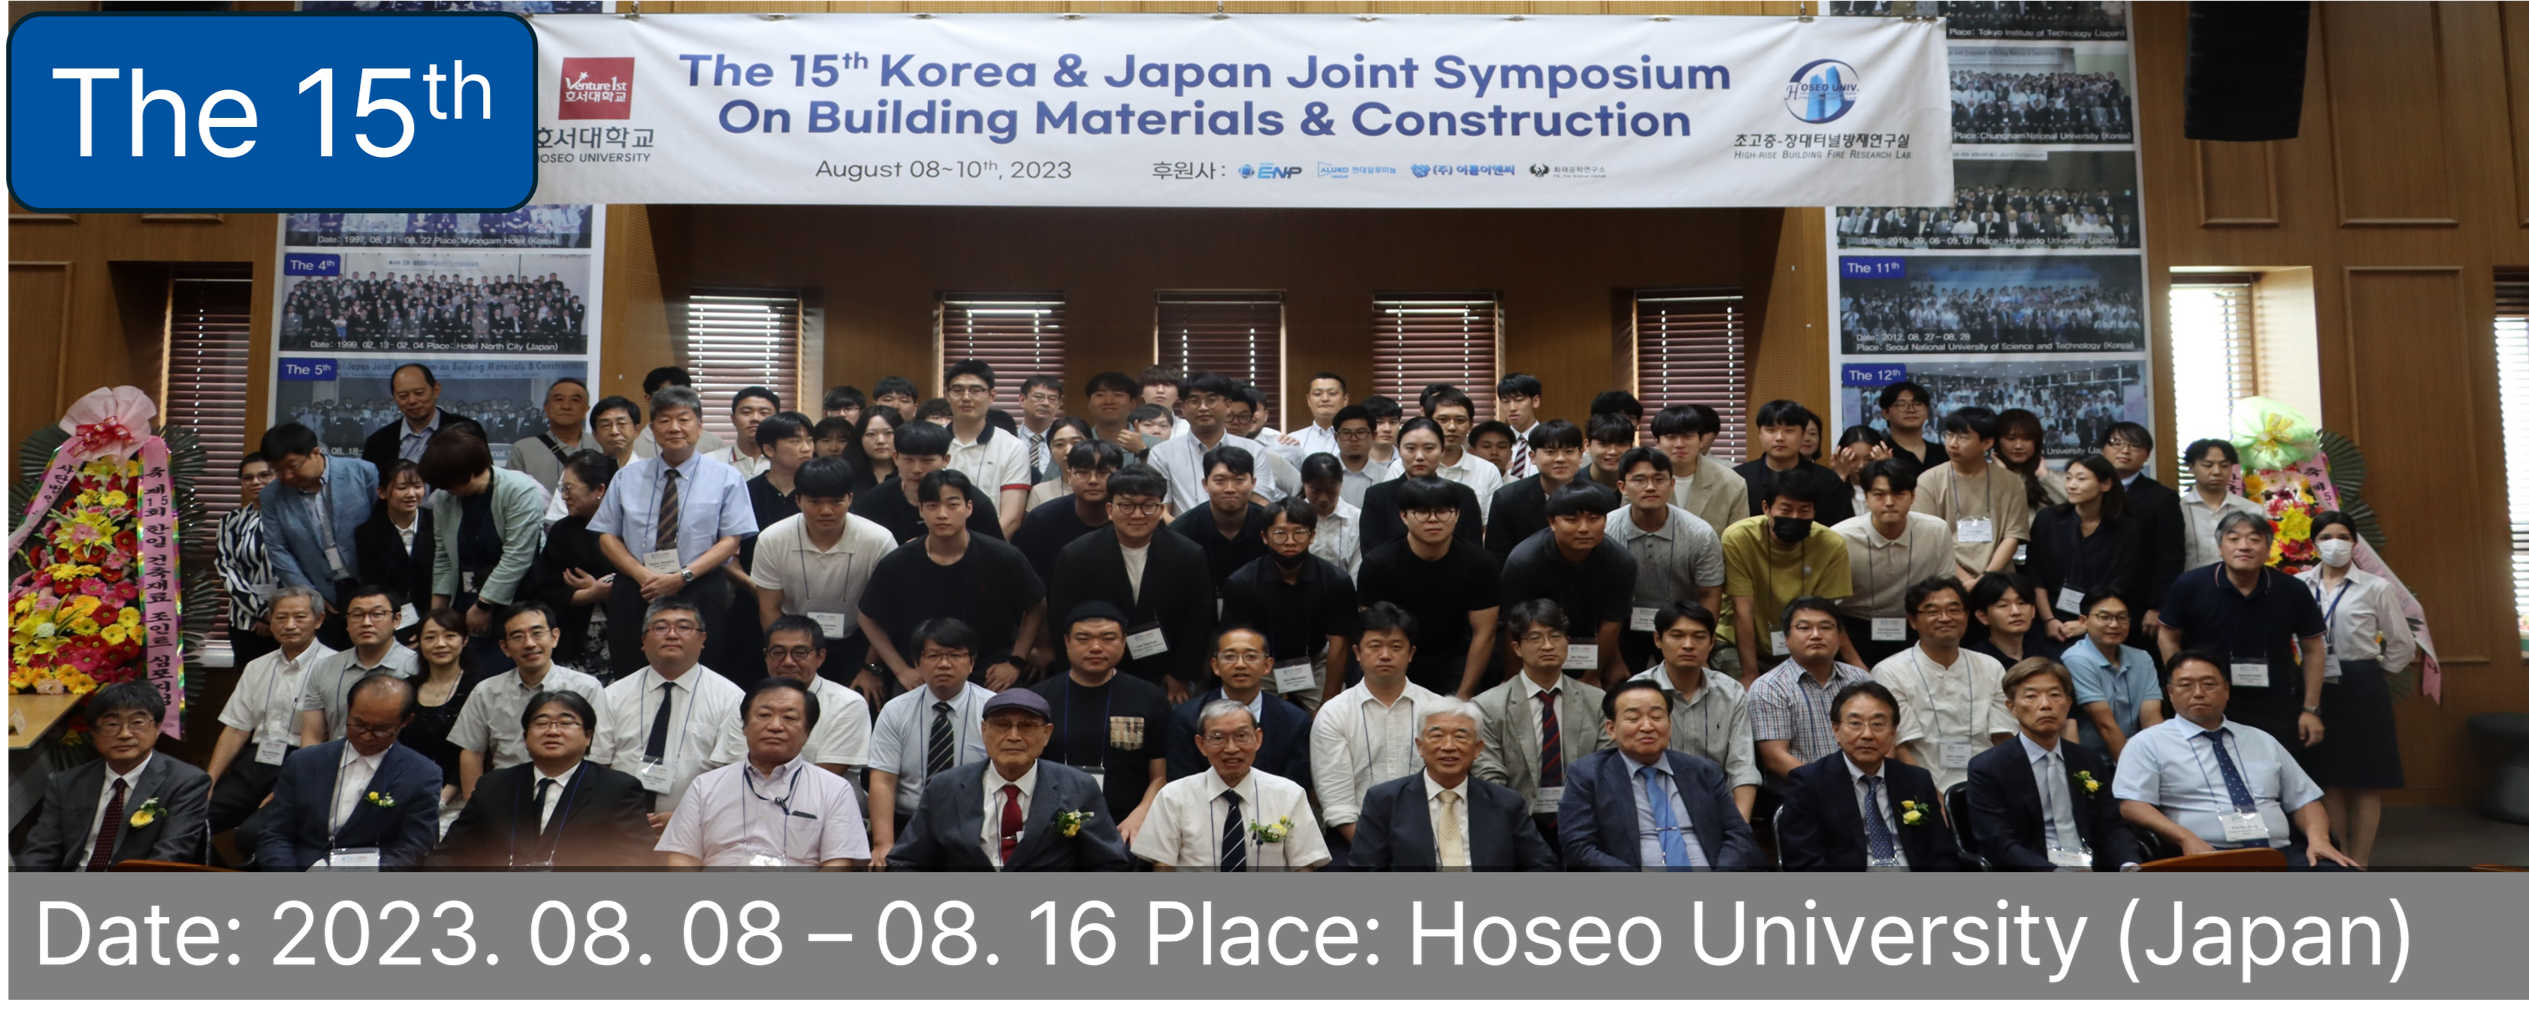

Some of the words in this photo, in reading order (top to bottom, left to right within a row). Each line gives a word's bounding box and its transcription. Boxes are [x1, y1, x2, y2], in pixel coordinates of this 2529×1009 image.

[1978, 28, 2003, 37] Tokyo
[2005, 28, 2034, 36] Institute
[2036, 28, 2044, 36] of
[2047, 29, 2092, 38] Technology
[2094, 29, 2125, 38] (Japan)
[679, 54, 773, 86] The
[789, 51, 869, 87] 15th
[881, 54, 1036, 87] Korea
[1054, 54, 1088, 87] &
[1104, 54, 1271, 97] Japan
[1287, 54, 1419, 88] Joint
[1434, 54, 1731, 98] Symposium
[1832, 83, 1860, 92] UNIV.
[565, 91, 627, 102] 호서대학교
[719, 99, 790, 133] On
[808, 98, 1017, 144] Building
[1036, 99, 1285, 136] Materials
[1301, 102, 1336, 136] &
[1352, 102, 1691, 137] Construction
[538, 126, 654, 149] 호서대학교
[2060, 132, 2098, 142] University
[2102, 132, 2131, 141] (Korea)
[580, 152, 651, 163] UNIVERSITY
[815, 160, 902, 182] August
[1011, 161, 1072, 180] 2023
[1152, 160, 1217, 181] 후원사
[1257, 166, 1303, 179] ENP
[1433, 164, 1453, 176] (주)
[318, 236, 341, 244] Date:
[420, 236, 432, 244] 22
[504, 236, 526, 245] Hotel
[528, 236, 559, 246] (Korea)
[1861, 237, 1884, 245] Date:
[1962, 237, 1974, 245] 07
[2006, 237, 2045, 245] Hokkaido
[2048, 237, 2085, 246] University
[2088, 237, 2119, 246] (Japan)
[290, 260, 314, 270] The
[318, 260, 335, 270] 4th
[1847, 262, 1872, 273] The
[1877, 262, 1900, 273] 11th
[1856, 334, 1879, 342] Date:
[1960, 334, 1971, 342] 28
[413, 342, 424, 350] 04
[456, 342, 478, 350] Hotel
[481, 342, 504, 350] North
[507, 342, 524, 352] City
[526, 342, 558, 352] (Japan)
[1885, 343, 1909, 351] Seoul
[1911, 343, 1946, 351] National
[1948, 343, 1988, 352] University
[1990, 343, 2000, 351] of
[2002, 342, 2034, 350] Science
[2036, 342, 2052, 350] and
[2055, 342, 2101, 352] Technology
[2104, 342, 2134, 350] (Korea)
[286, 364, 310, 375] The
[314, 364, 331, 375] 5th
[1849, 370, 1873, 381] The
[1877, 370, 1900, 381] 12th
[2046, 448, 2086, 456] University
